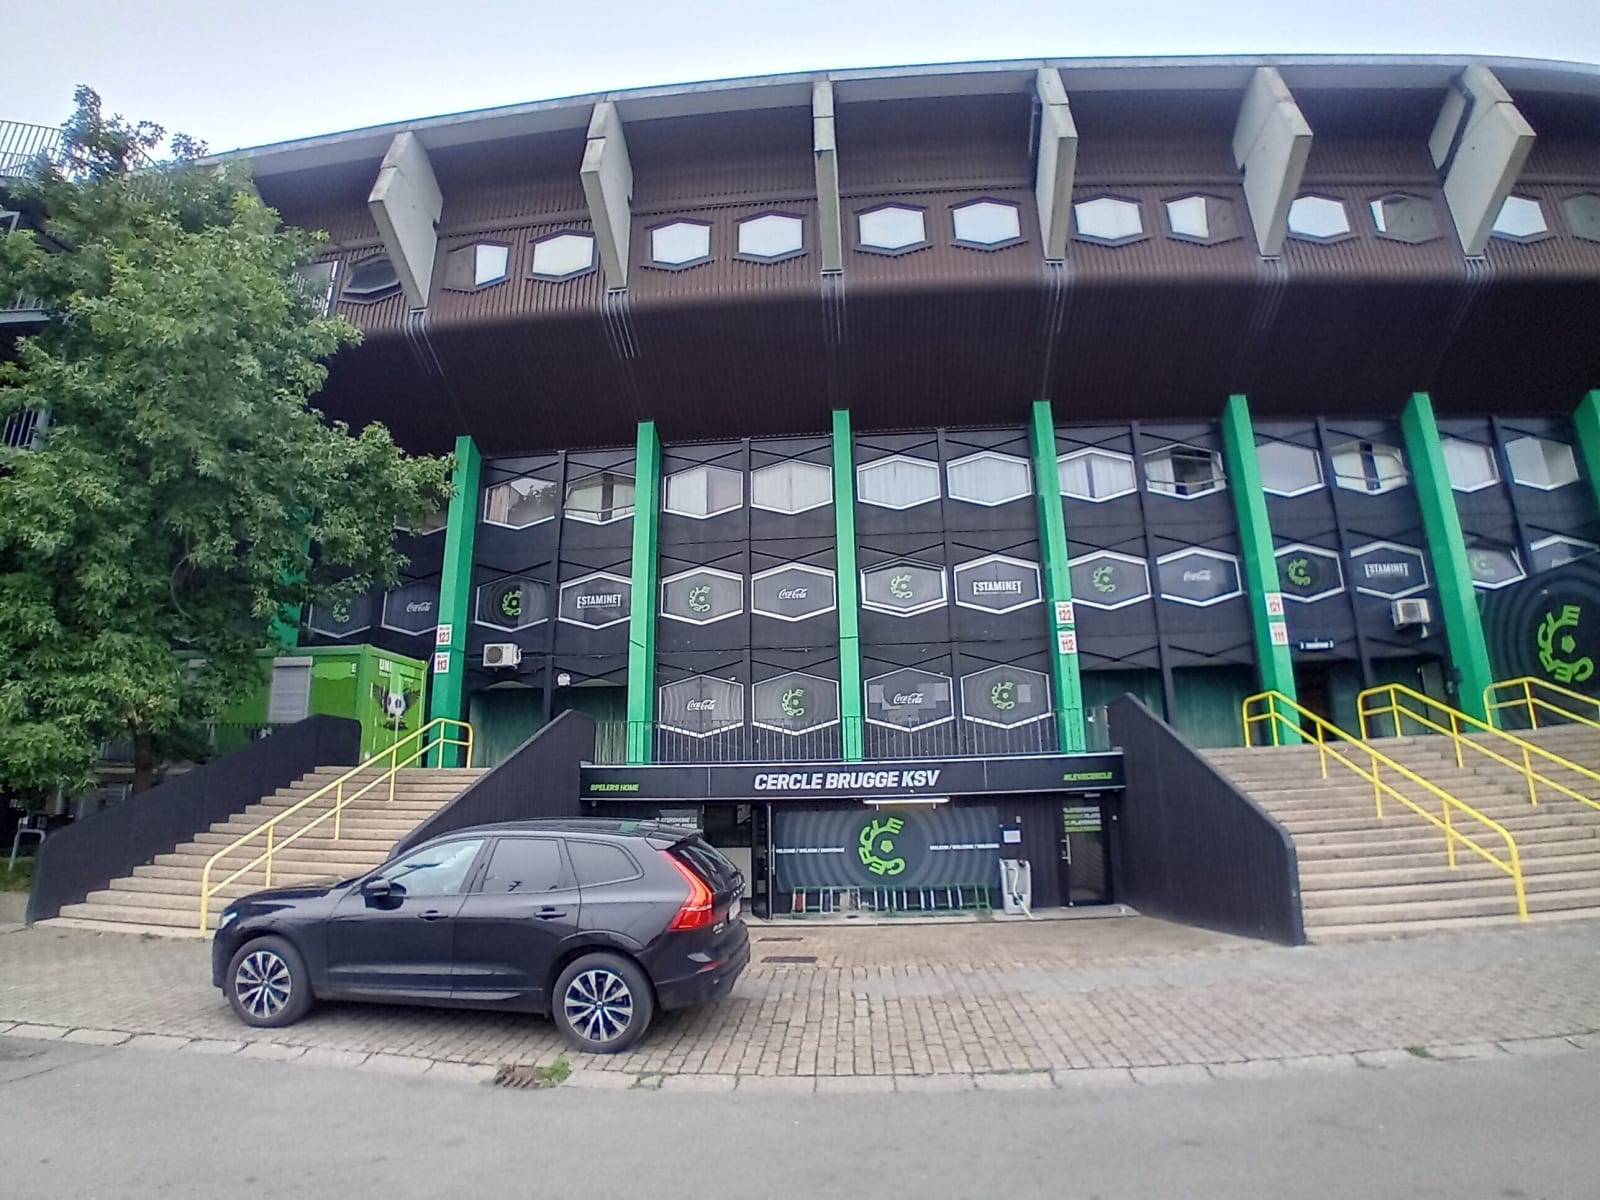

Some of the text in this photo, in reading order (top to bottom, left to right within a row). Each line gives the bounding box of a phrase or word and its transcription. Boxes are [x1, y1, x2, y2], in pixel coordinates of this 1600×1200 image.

[973, 580, 1022, 595] ESTAMINET
[576, 594, 622, 609] ESTAMINET
[1059, 609, 1072, 621] 122
[754, 769, 941, 790] CERCLE BRUGGE KSV
